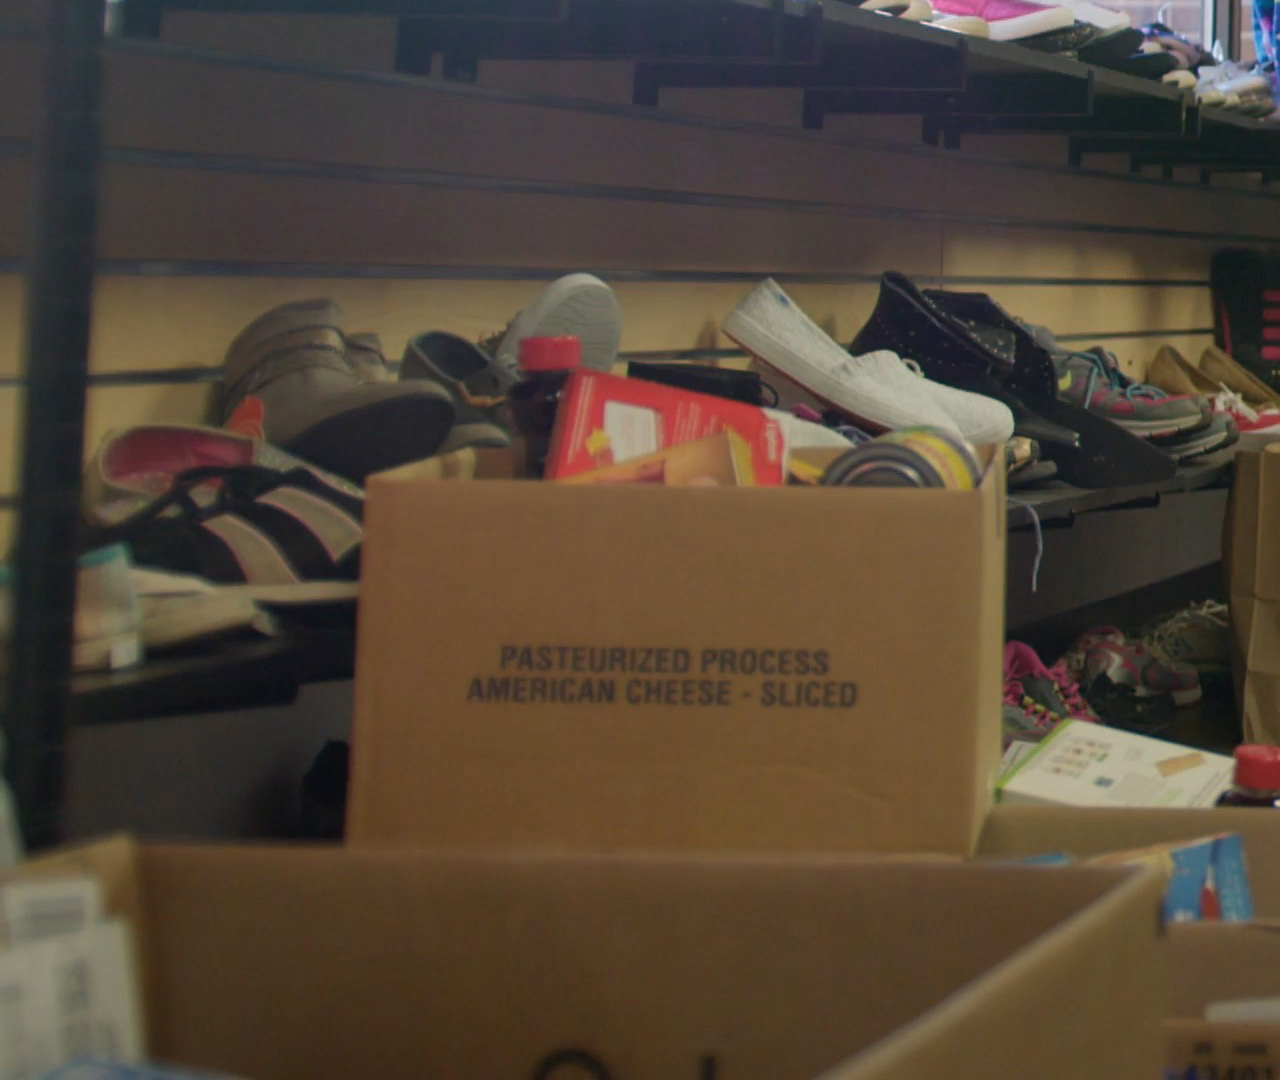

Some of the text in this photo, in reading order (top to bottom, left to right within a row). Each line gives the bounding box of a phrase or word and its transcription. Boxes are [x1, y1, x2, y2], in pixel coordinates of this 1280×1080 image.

[499, 645, 830, 676] PASTEURIZED PROCESS
[466, 676, 617, 704] AMERICAN
[625, 678, 733, 706] CHEESE
[759, 681, 859, 709] SLICED
